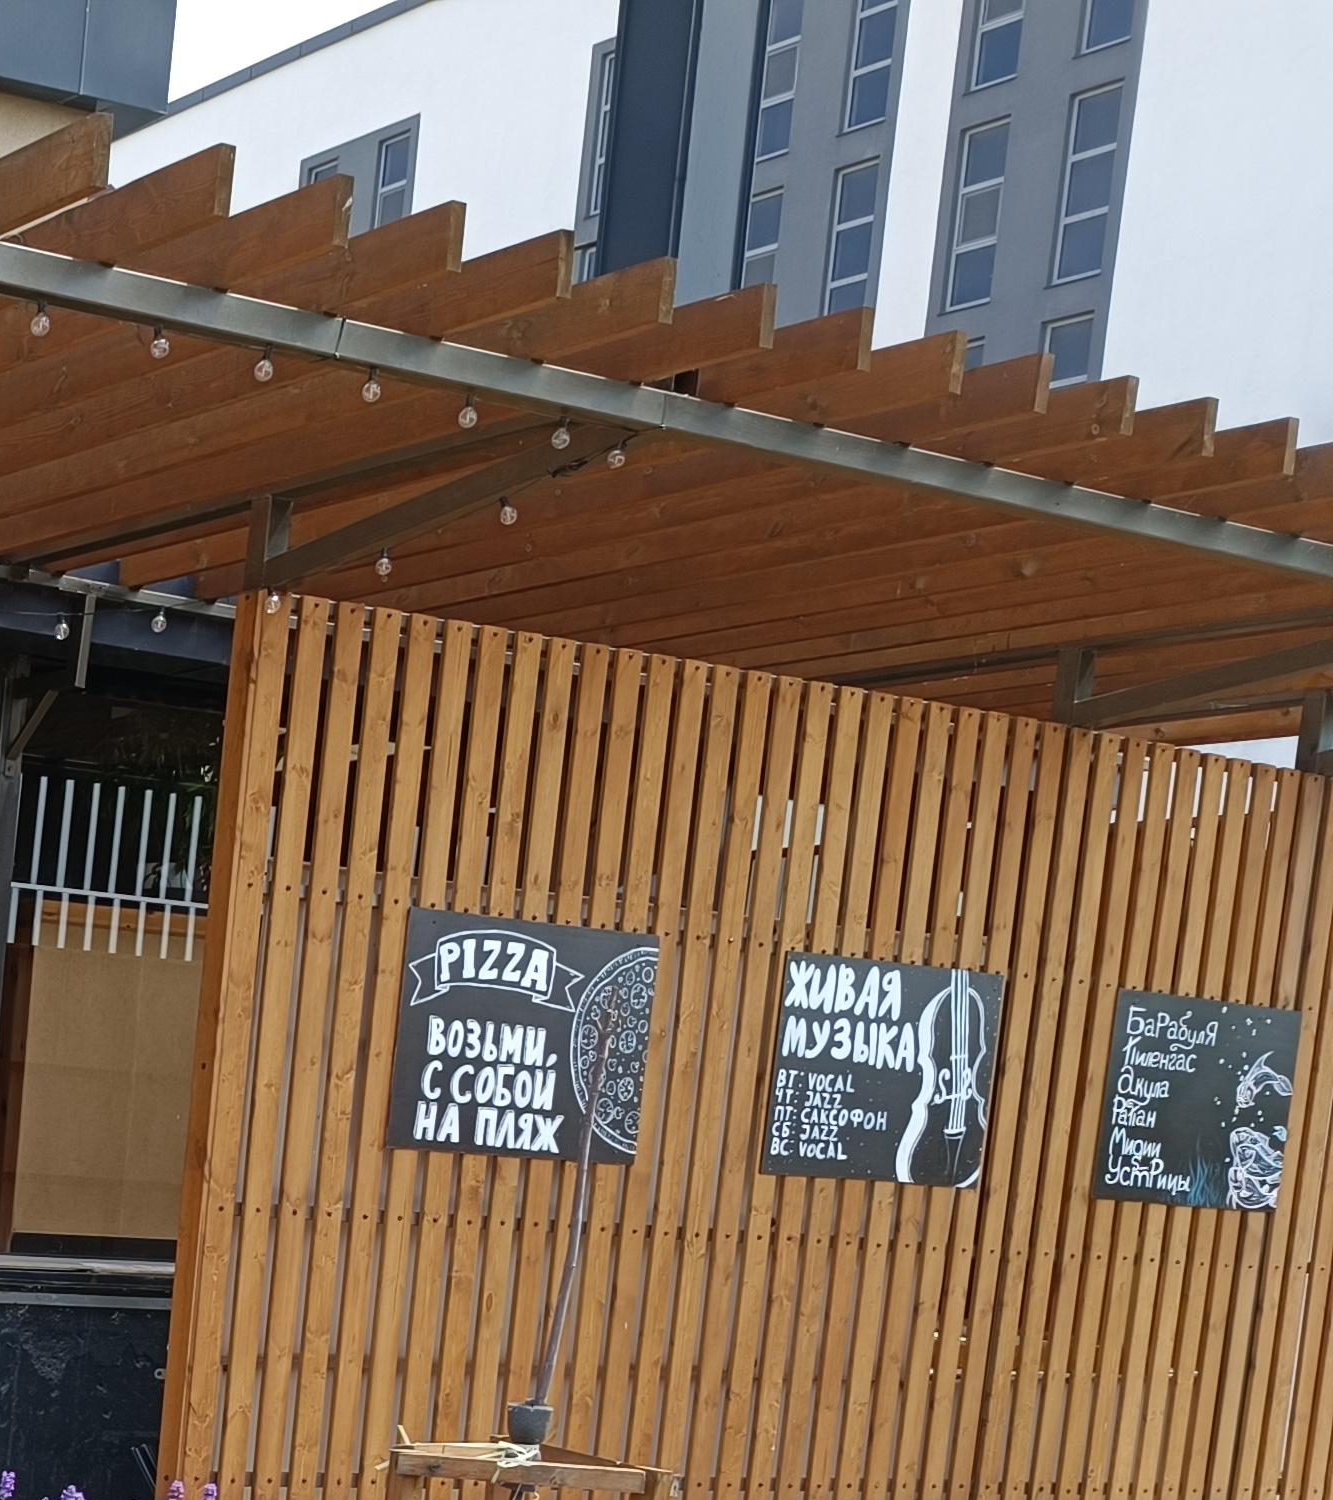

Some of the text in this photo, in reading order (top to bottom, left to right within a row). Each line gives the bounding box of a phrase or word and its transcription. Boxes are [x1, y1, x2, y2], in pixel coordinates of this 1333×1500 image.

[439, 938, 550, 992] PIZZA
[784, 960, 902, 1021] ЖИВАЯ
[782, 1015, 915, 1073] МУЗЫКА
[420, 1060, 443, 1100] С
[808, 1072, 855, 1093] VOCAL
[804, 1091, 842, 1109] JAZZ
[412, 1100, 565, 1154] НА ПЛЯЖ
[799, 1124, 839, 1142] JAZZ
[800, 1108, 888, 1131] САКСОФОН
[799, 1141, 848, 1161] VOCAL
